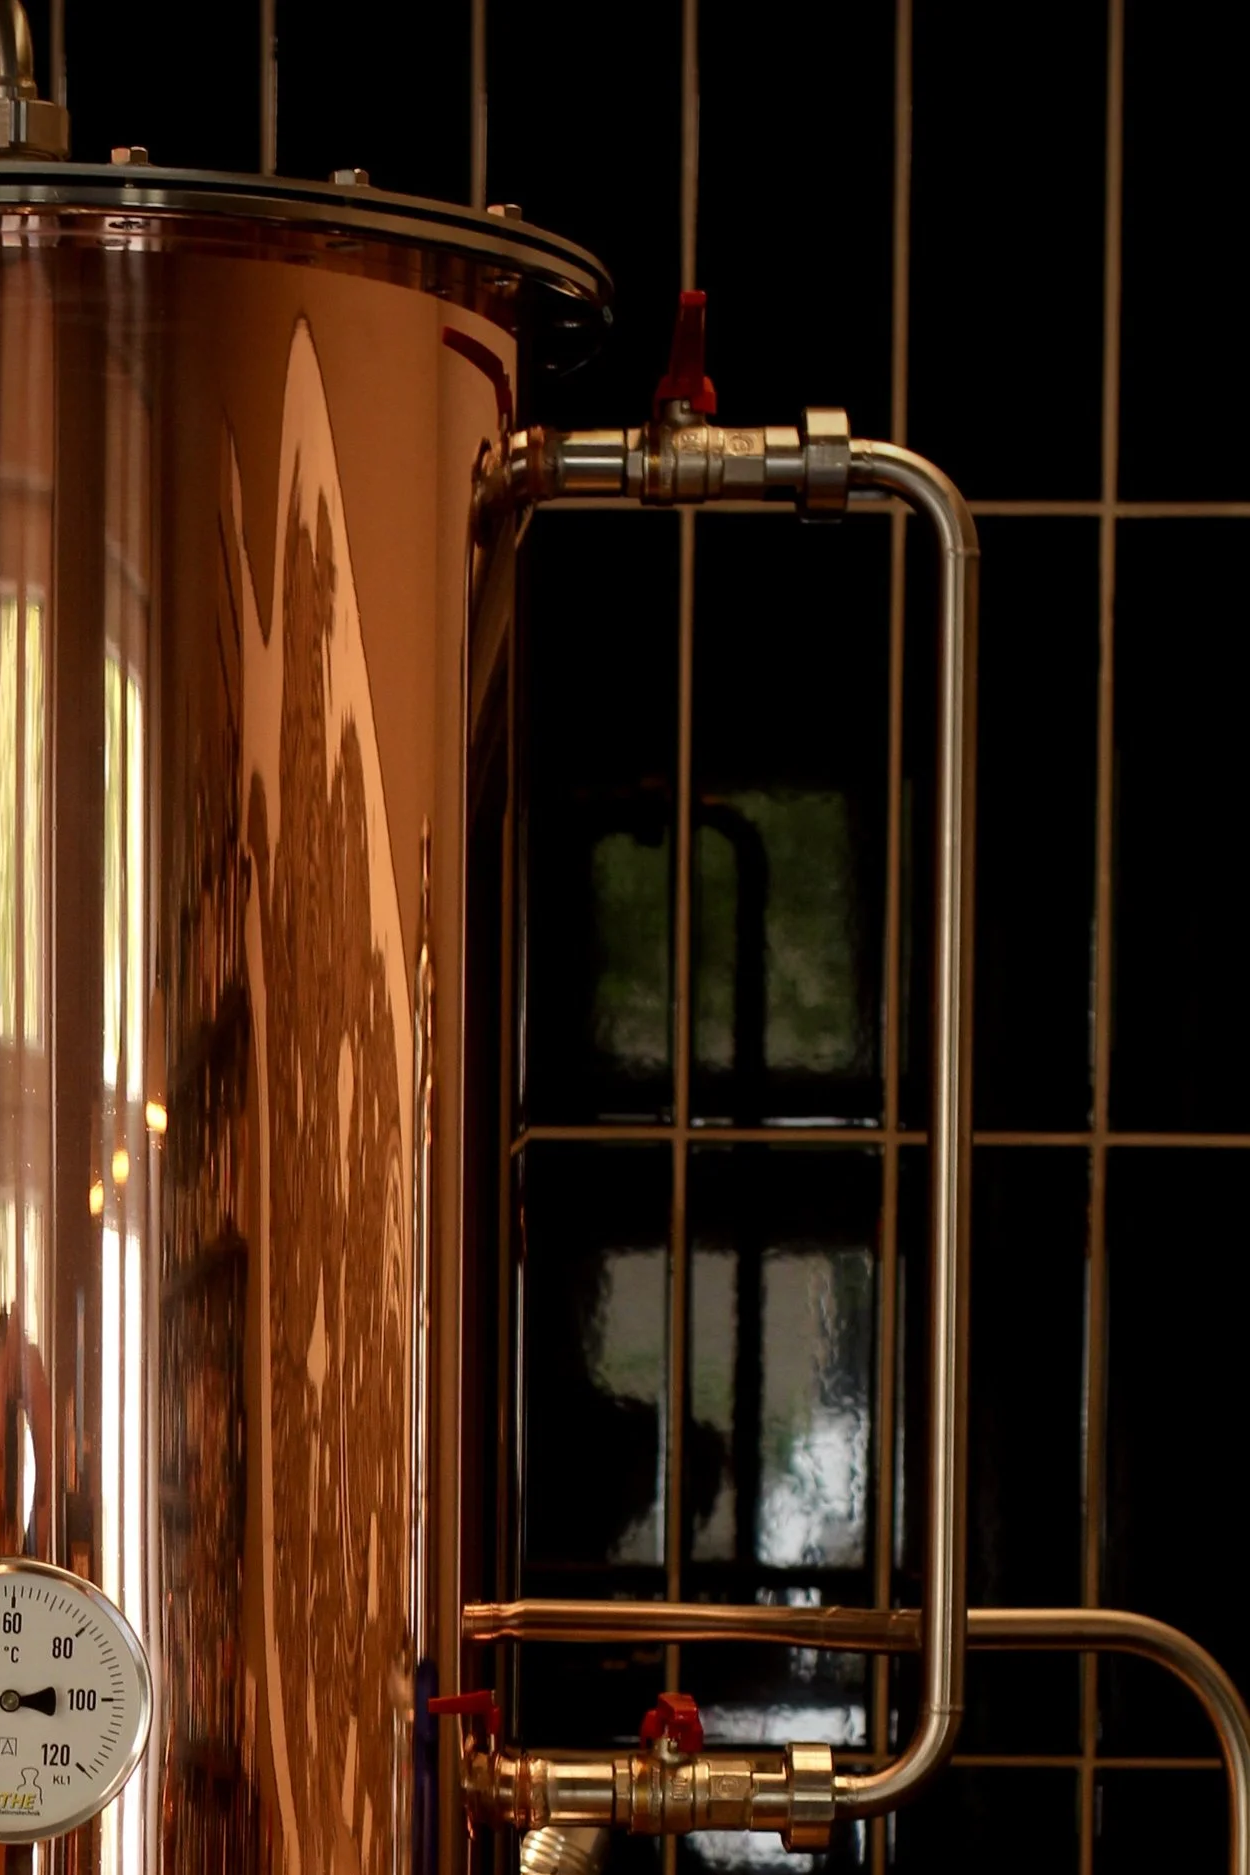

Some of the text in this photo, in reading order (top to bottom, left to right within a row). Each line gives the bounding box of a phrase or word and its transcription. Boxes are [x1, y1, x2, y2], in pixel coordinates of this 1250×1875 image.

[2, 1612, 22, 1634] 60
[3, 1646, 20, 1663] °C
[52, 1637, 73, 1659] 80
[67, 1689, 97, 1711] 100
[41, 1743, 70, 1767] 120
